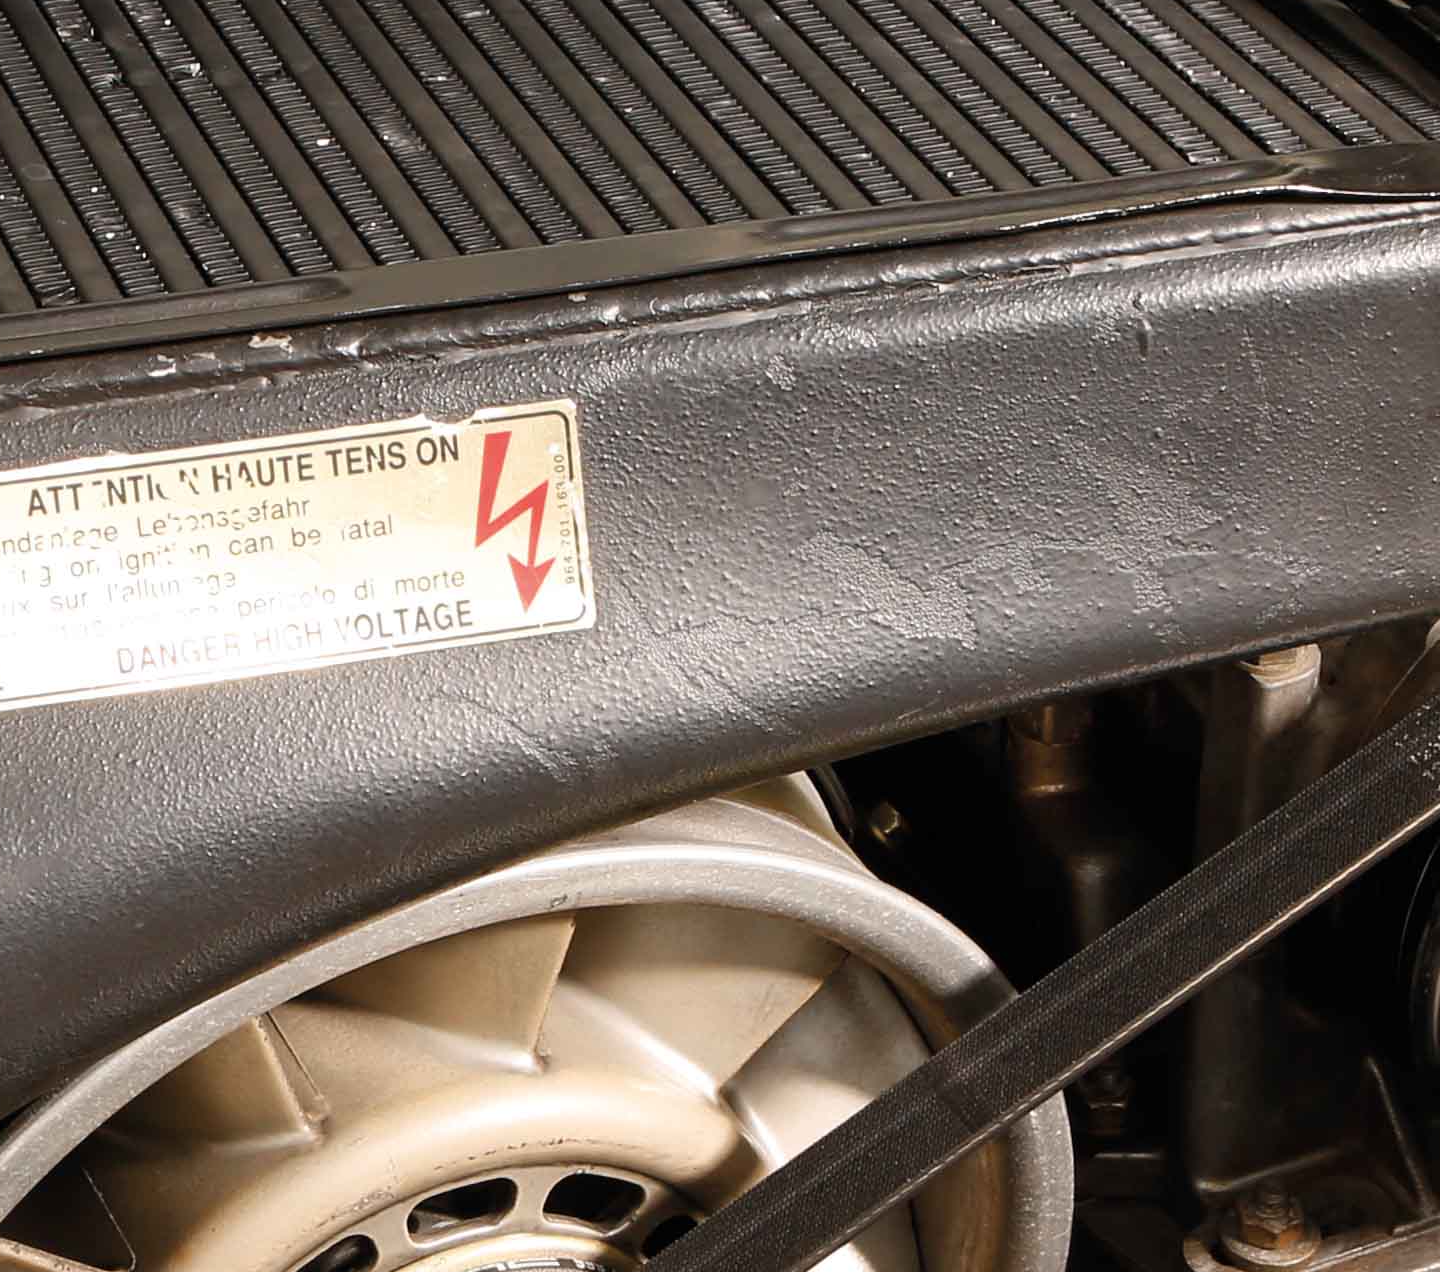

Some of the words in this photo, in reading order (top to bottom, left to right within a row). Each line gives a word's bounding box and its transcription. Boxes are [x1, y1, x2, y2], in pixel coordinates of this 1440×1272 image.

[325, 433, 460, 479] TENSON
[228, 534, 274, 556] can
[394, 568, 466, 595] morte
[334, 599, 473, 643] VOLTAGE
